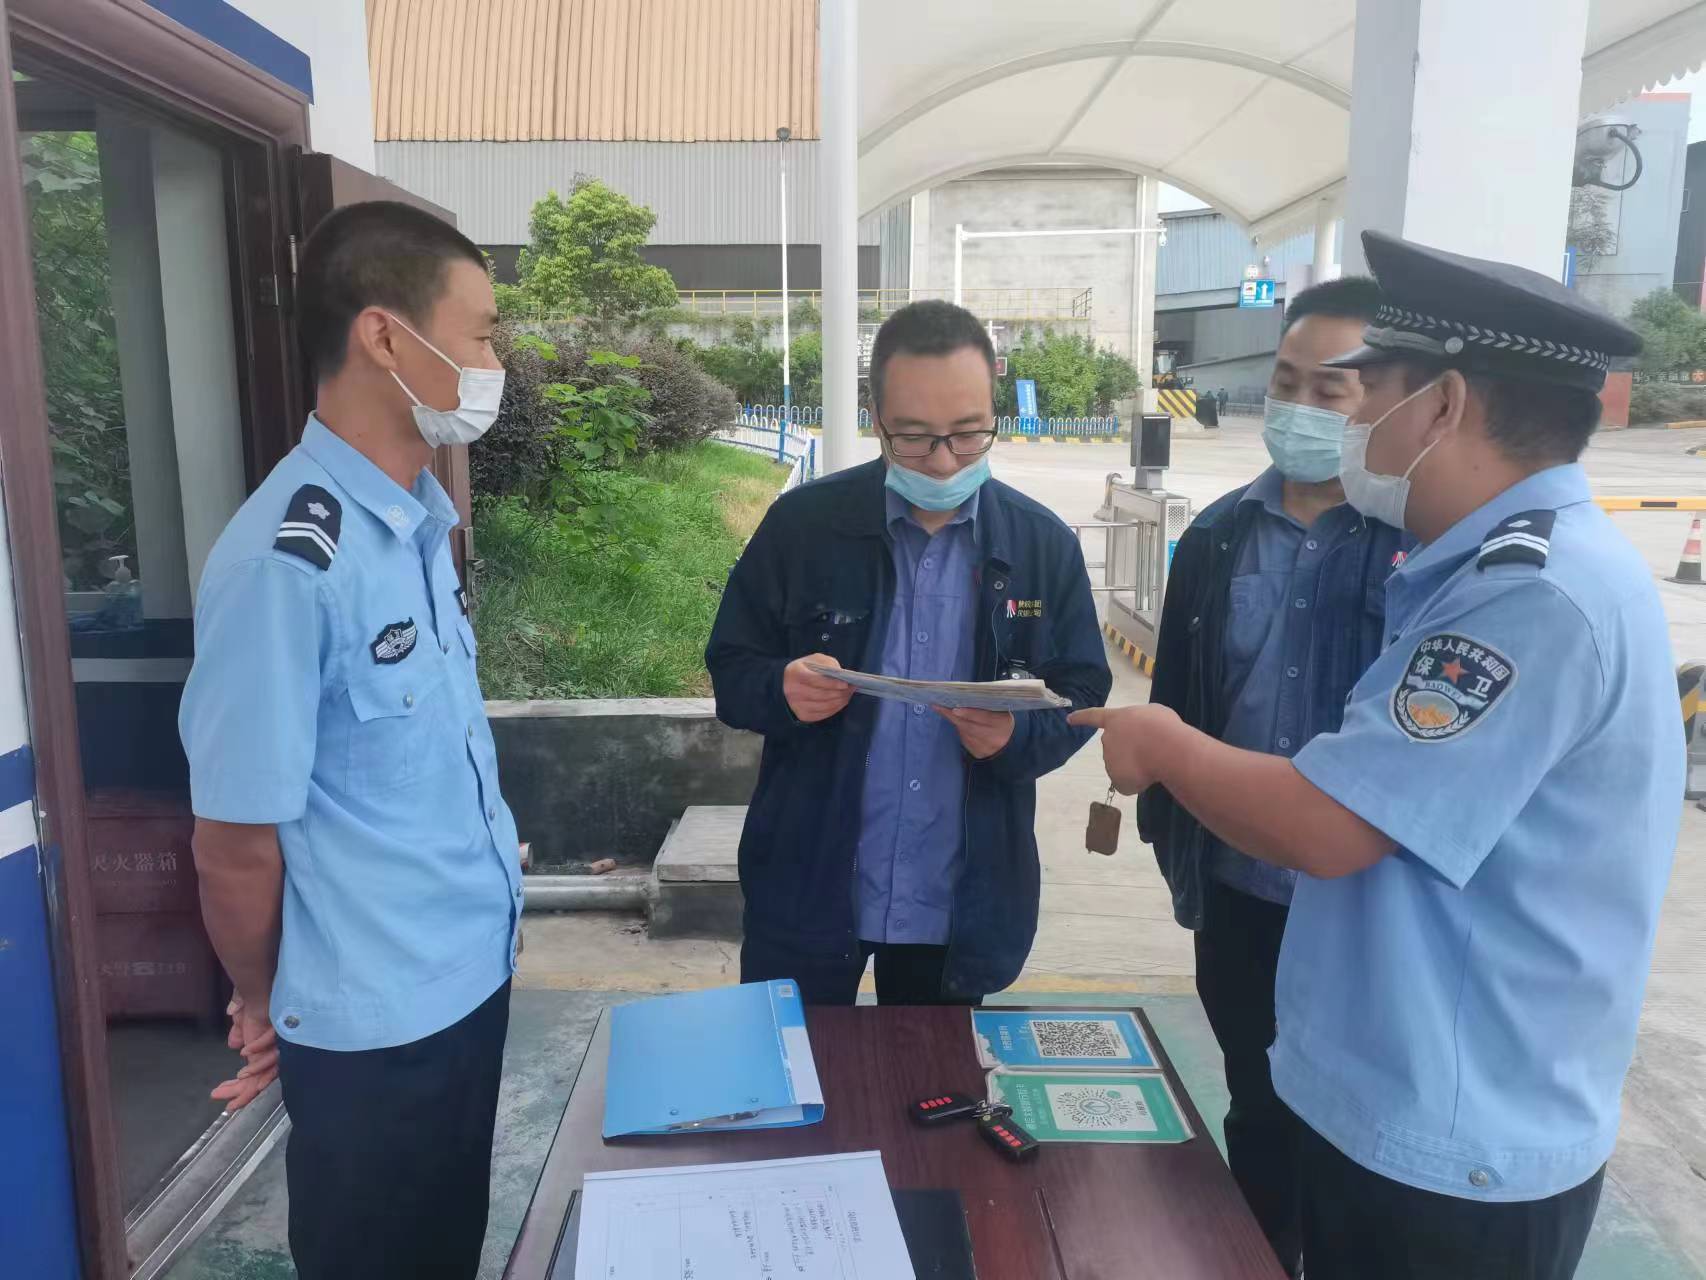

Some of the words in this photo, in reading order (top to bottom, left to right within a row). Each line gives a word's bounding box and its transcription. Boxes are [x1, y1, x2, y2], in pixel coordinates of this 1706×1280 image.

[1420, 639, 1511, 682] 中华人民共和国
